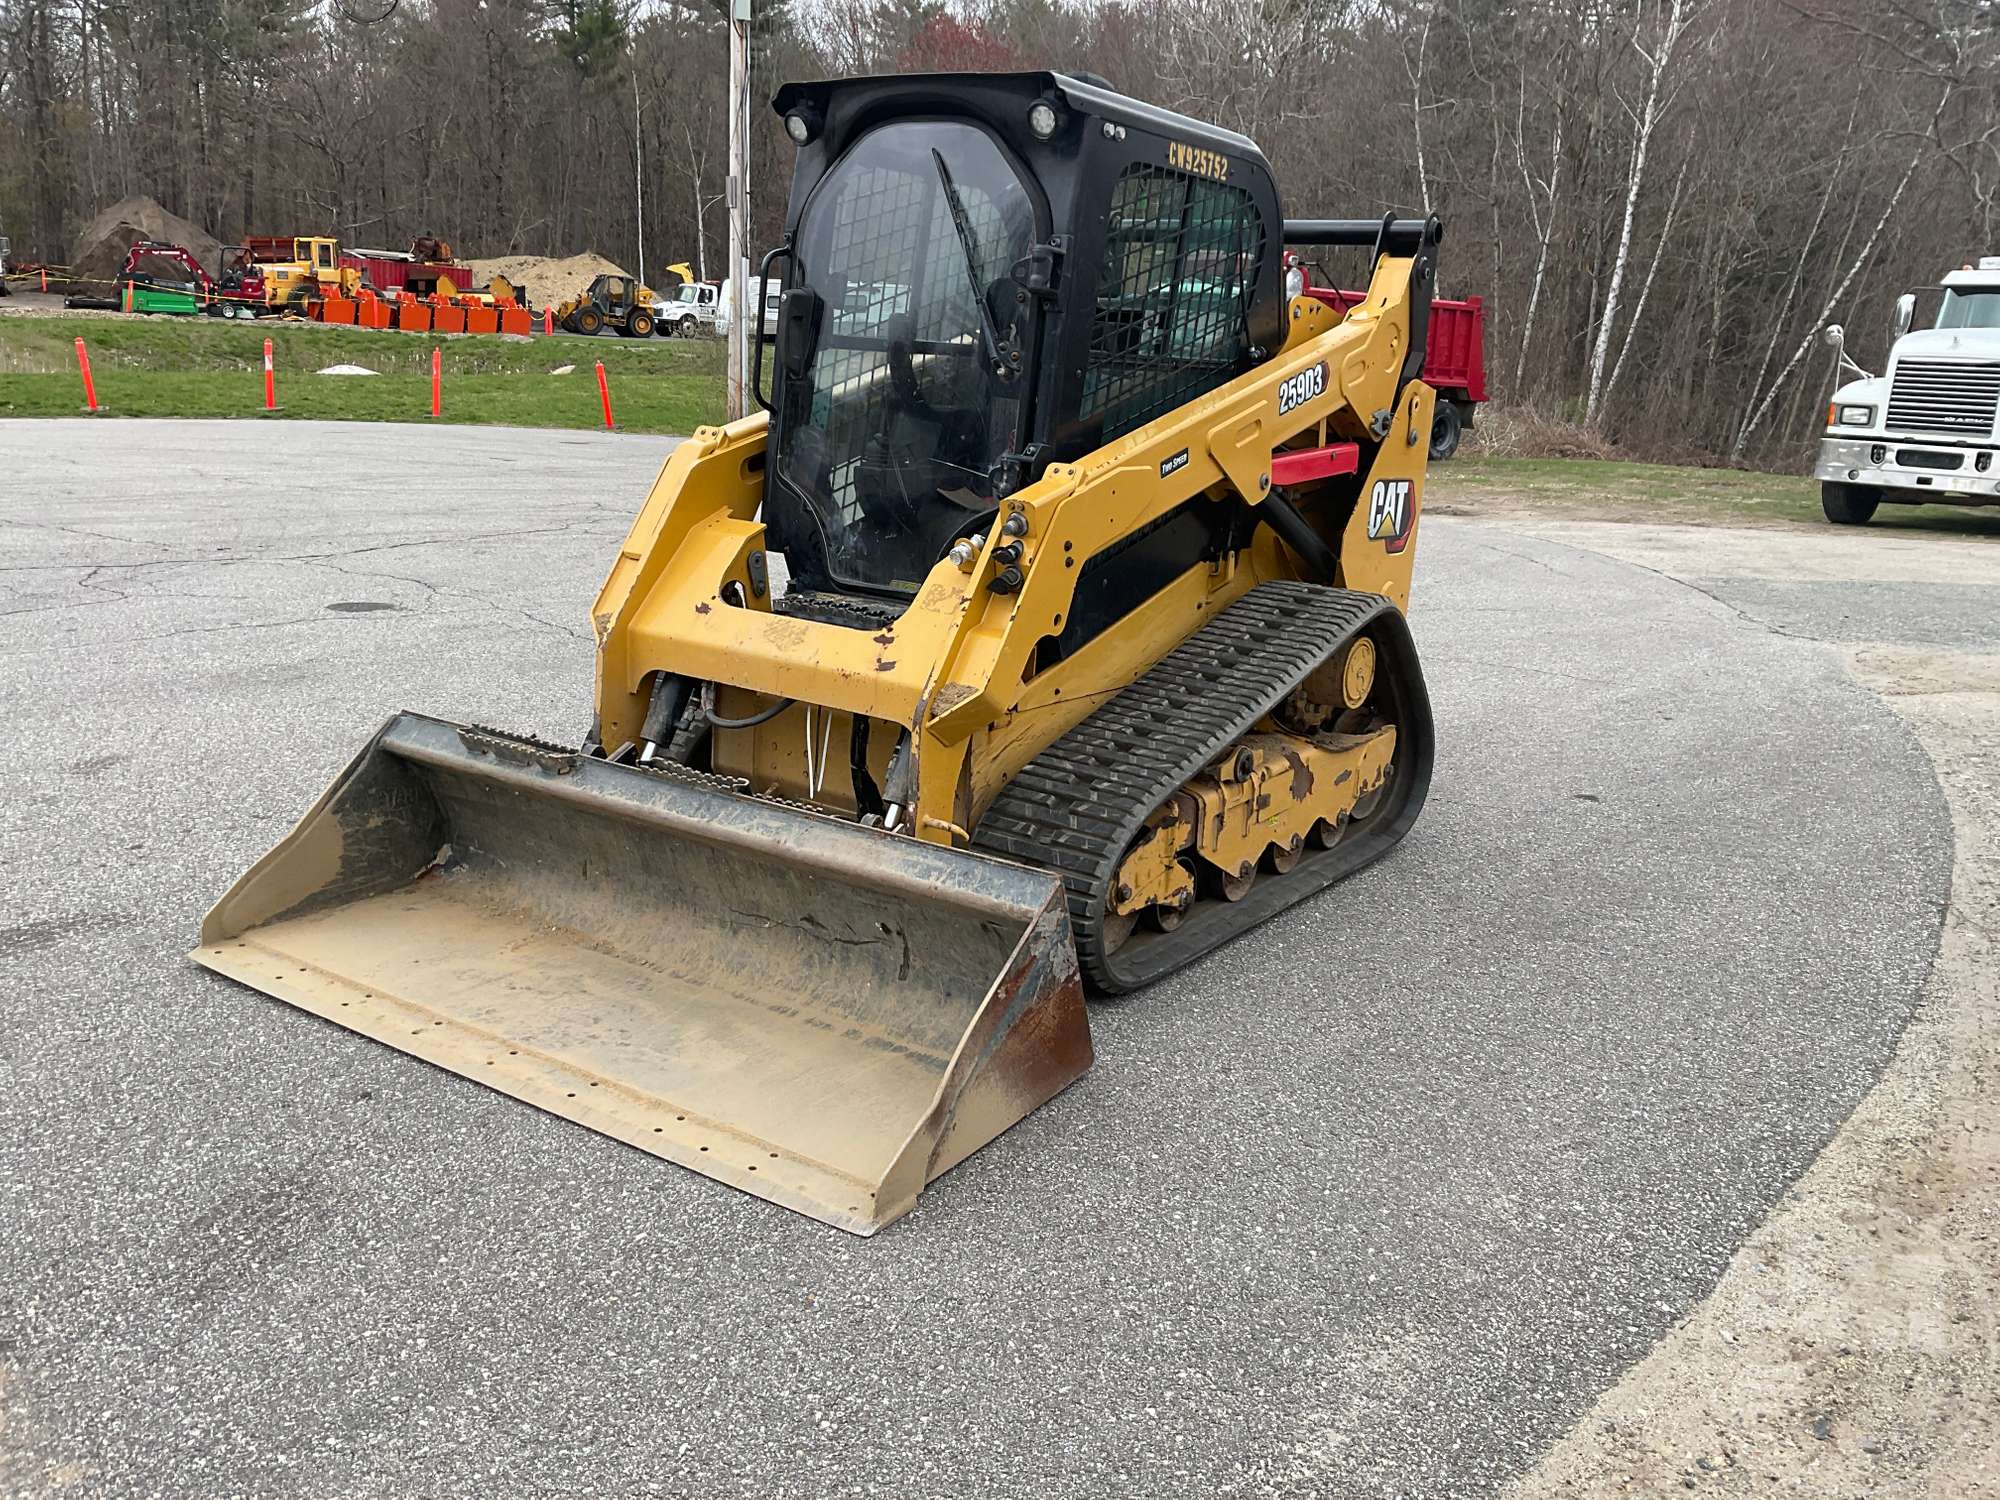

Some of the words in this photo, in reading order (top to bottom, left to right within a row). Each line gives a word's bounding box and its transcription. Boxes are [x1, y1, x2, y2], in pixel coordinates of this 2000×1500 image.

[1169, 142, 1228, 181] CW925752
[1279, 363, 1323, 415] 259D3
[1369, 481, 1409, 538] CAT
